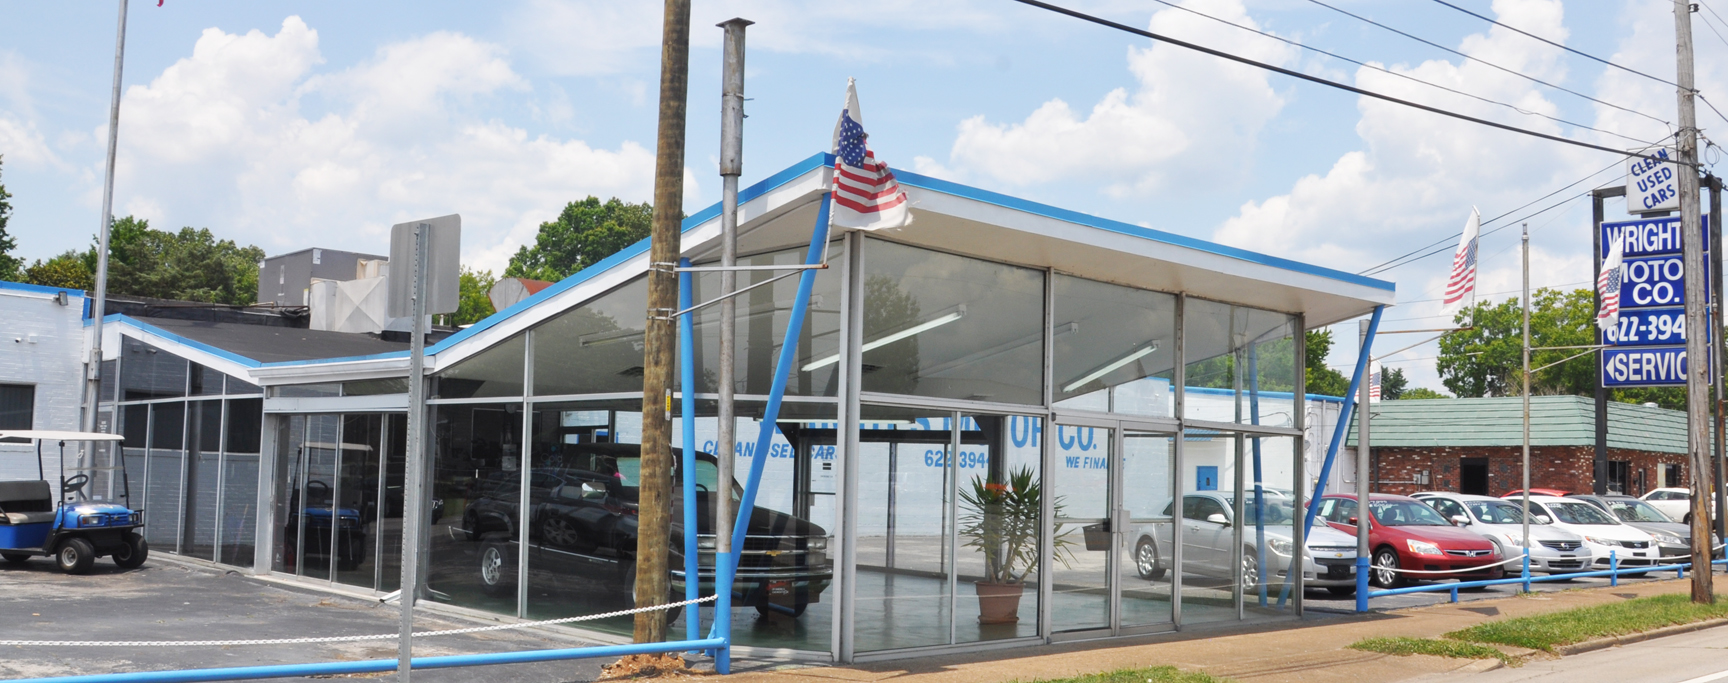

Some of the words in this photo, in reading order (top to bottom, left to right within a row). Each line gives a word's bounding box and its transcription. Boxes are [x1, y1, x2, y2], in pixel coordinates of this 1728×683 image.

[1631, 148, 1670, 177] CLEAN
[1637, 167, 1672, 193] USED
[1643, 184, 1676, 210] CARS
[1606, 221, 1682, 253] WRIGHT
[1620, 258, 1684, 284] OTO
[1632, 282, 1680, 305] CO.
[1606, 314, 1687, 342] 622-394
[1614, 351, 1687, 382] SERVIC
[703, 440, 756, 459] CLAN
[1066, 455, 1080, 469] WE
